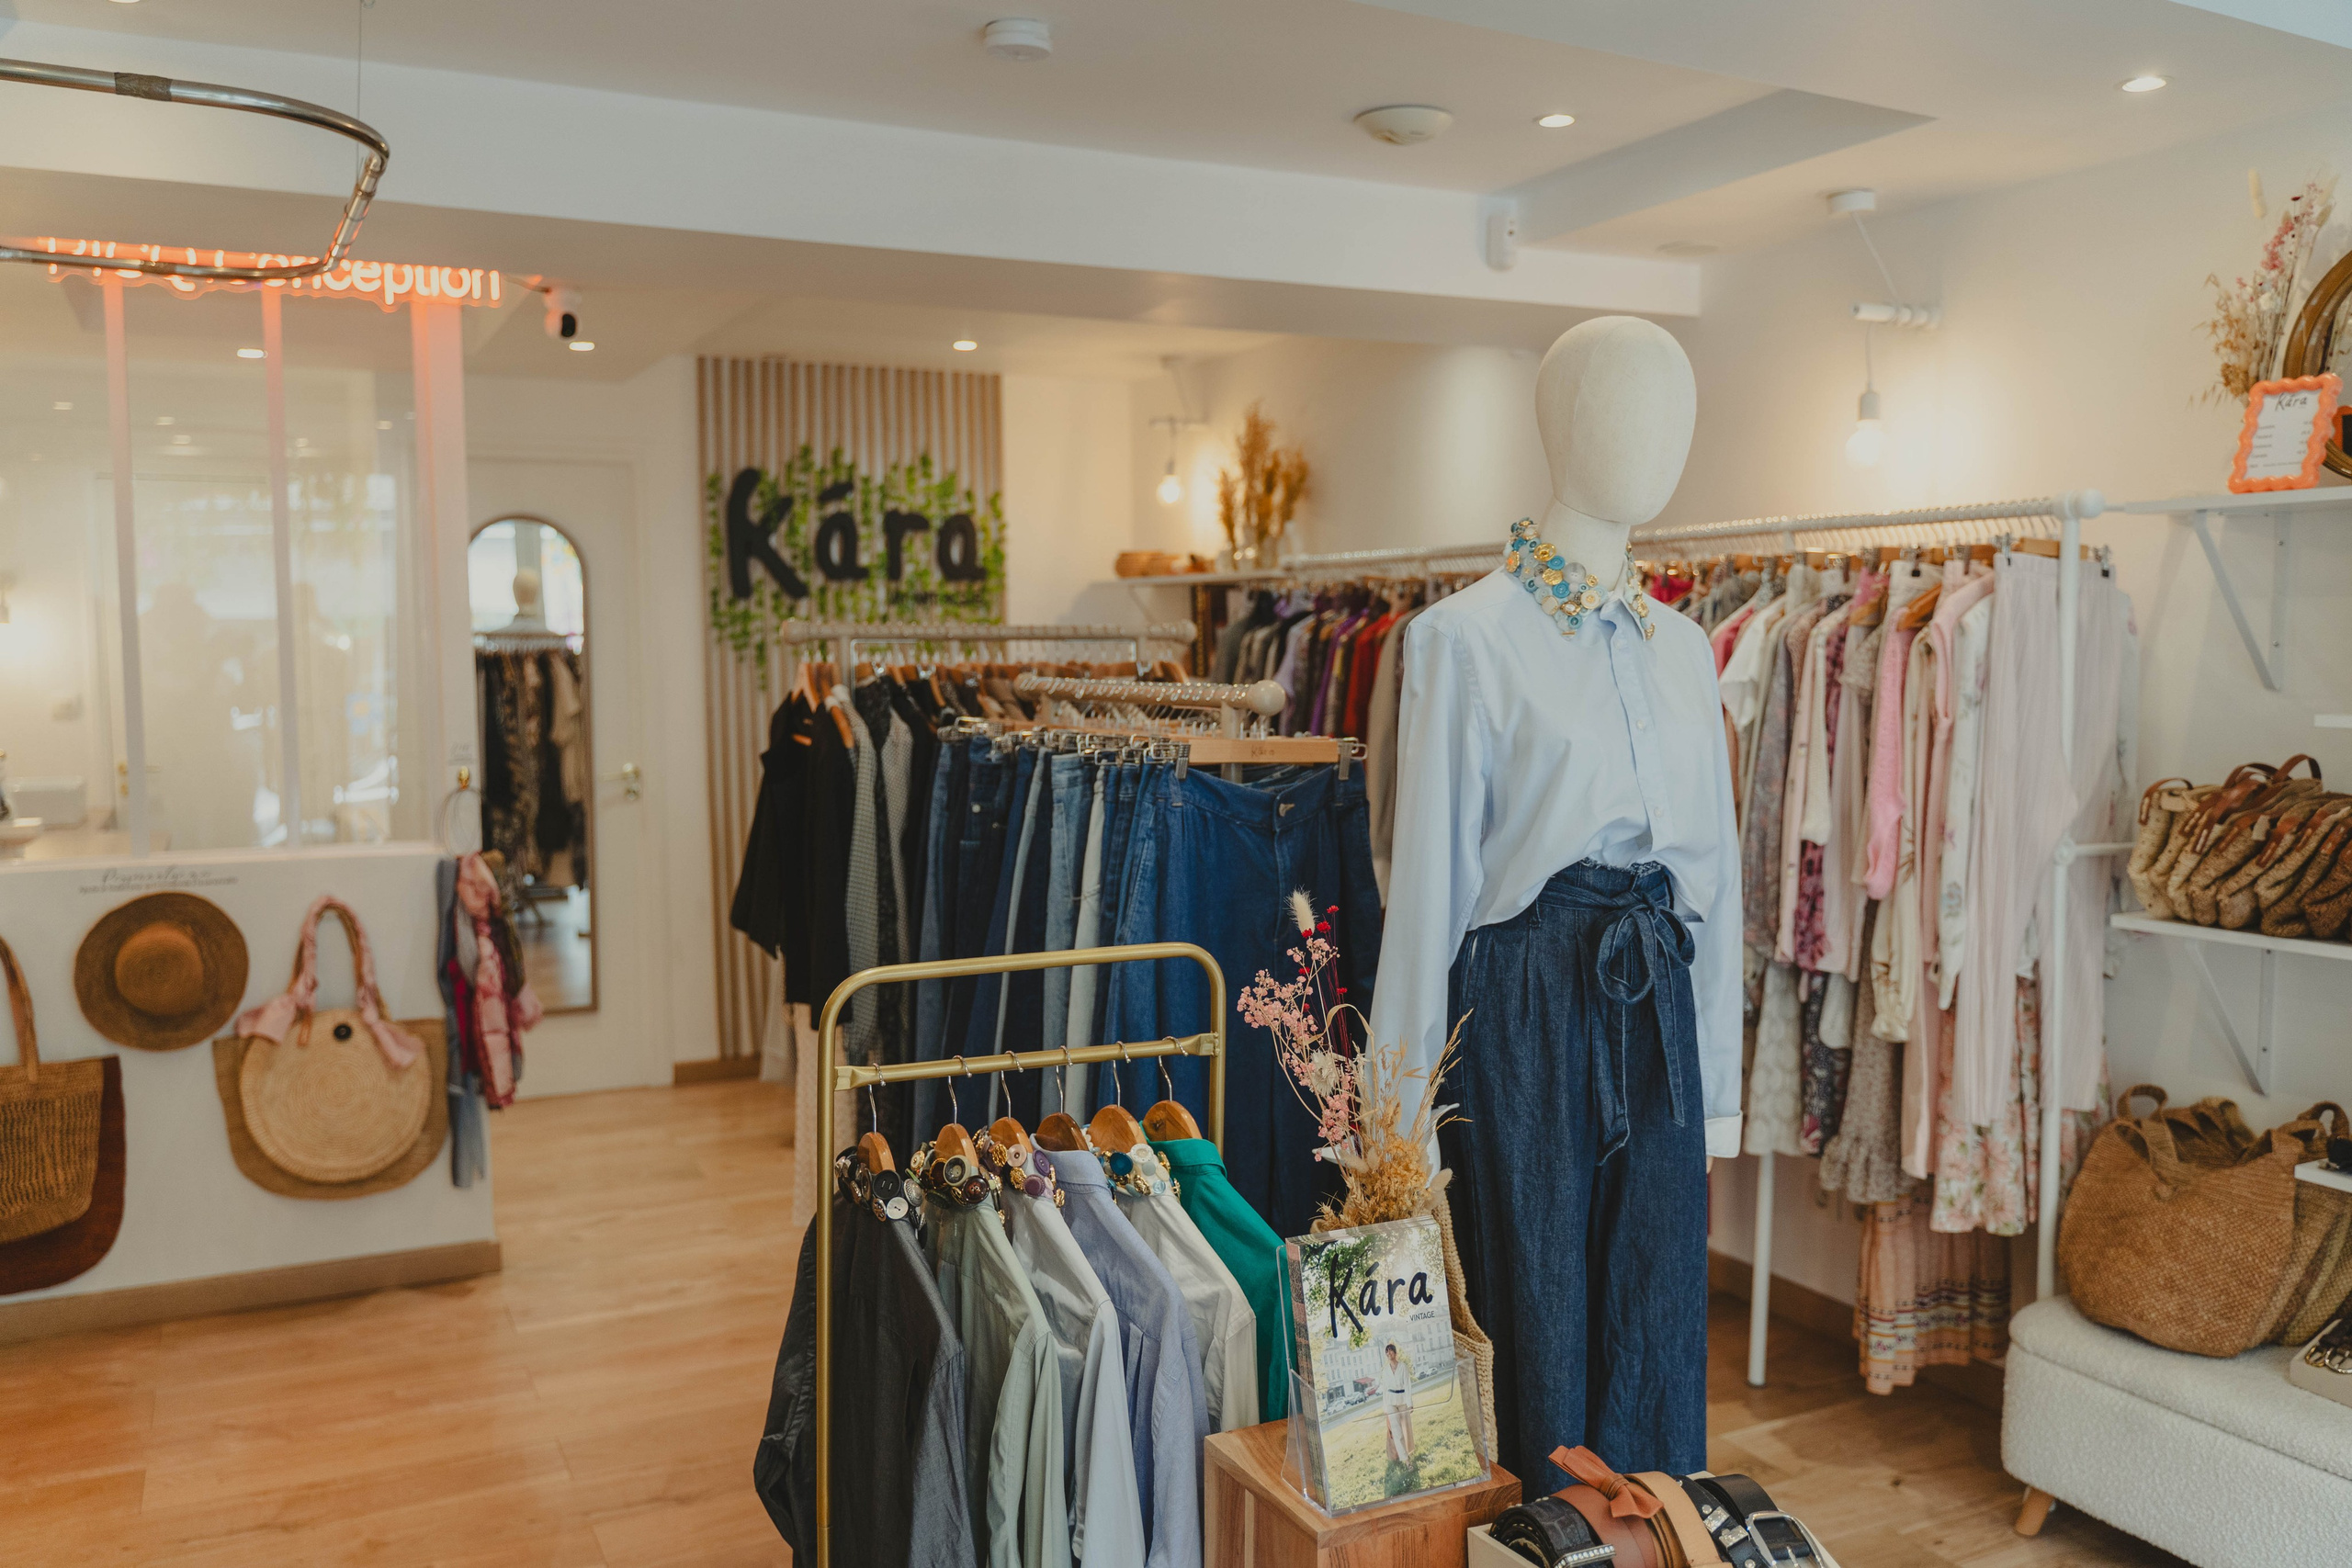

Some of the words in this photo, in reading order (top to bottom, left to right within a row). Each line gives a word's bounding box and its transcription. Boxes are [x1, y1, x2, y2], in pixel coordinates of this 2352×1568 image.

[2275, 392, 2308, 412] Kára
[727, 468, 987, 599] Kára
[1329, 1253, 1433, 1338] Kára
[1409, 1310, 1435, 1322] VINTAGE
